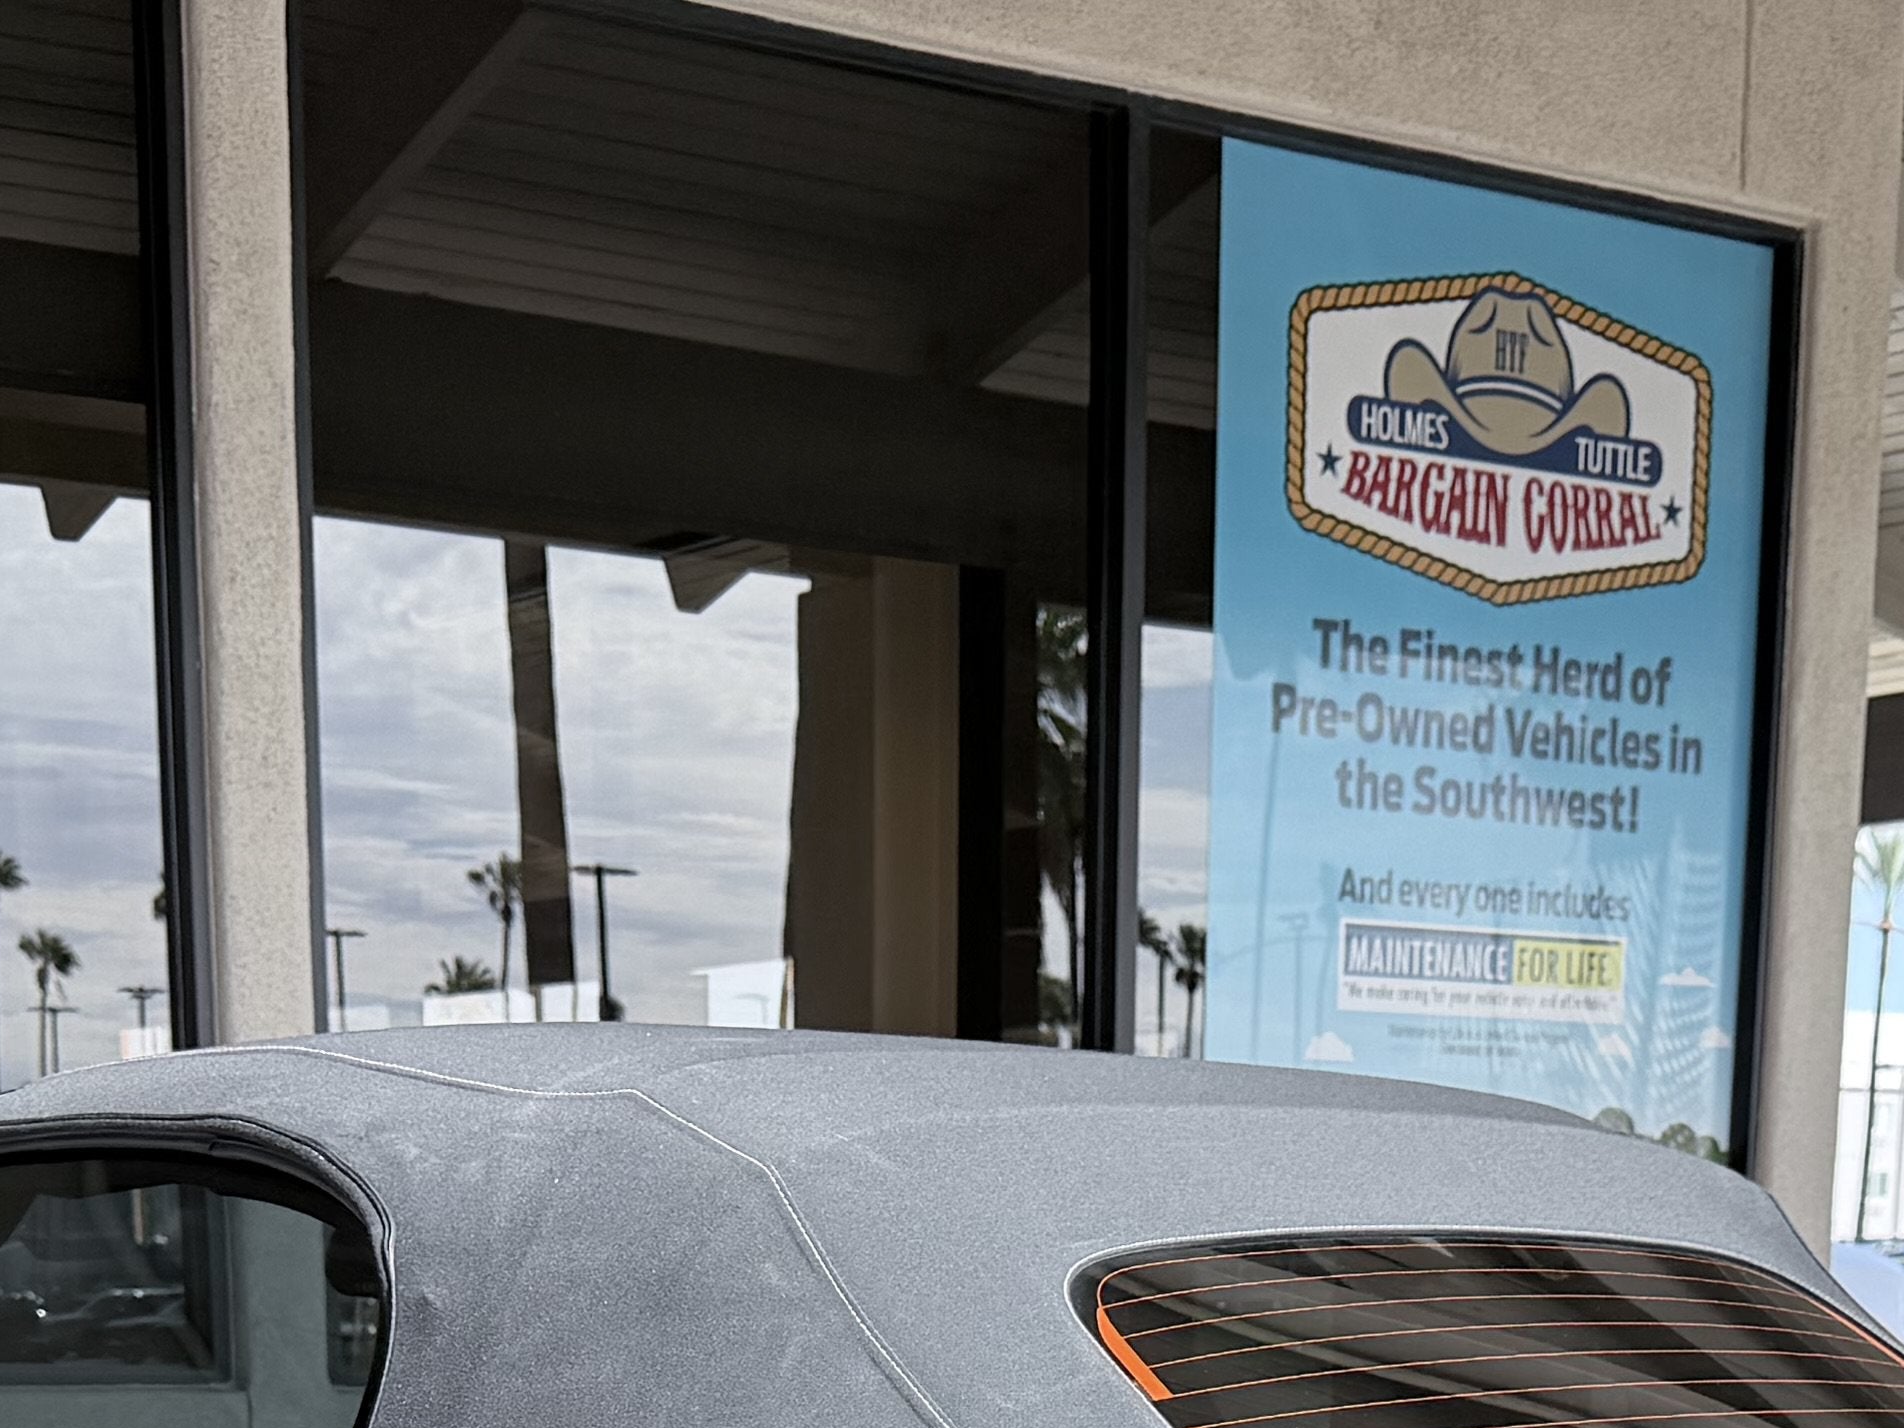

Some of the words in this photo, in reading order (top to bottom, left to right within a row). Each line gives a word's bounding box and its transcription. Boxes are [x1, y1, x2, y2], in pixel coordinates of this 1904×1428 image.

[1360, 402, 1450, 451] HOLMES
[1575, 436, 1653, 482] TUTTLE
[1340, 449, 1509, 548] BARGAIN
[1523, 476, 1661, 554] CORRAL
[1312, 617, 1389, 676] The
[1399, 627, 1524, 690] Finest
[1532, 643, 1623, 702] Herd
[1631, 655, 1673, 707] of
[1271, 681, 1495, 754] Pre-Owned
[1505, 706, 1662, 770] Vehicles
[1669, 722, 1703, 775] in
[1335, 757, 1403, 812] the
[1412, 765, 1639, 833] Southwest!
[1338, 867, 1394, 905] And
[1398, 876, 1472, 918] every
[1475, 883, 1523, 914] one
[1527, 881, 1631, 921] includes
[1349, 934, 1508, 981] MAINTENANCE
[1517, 947, 1558, 984] FOR
